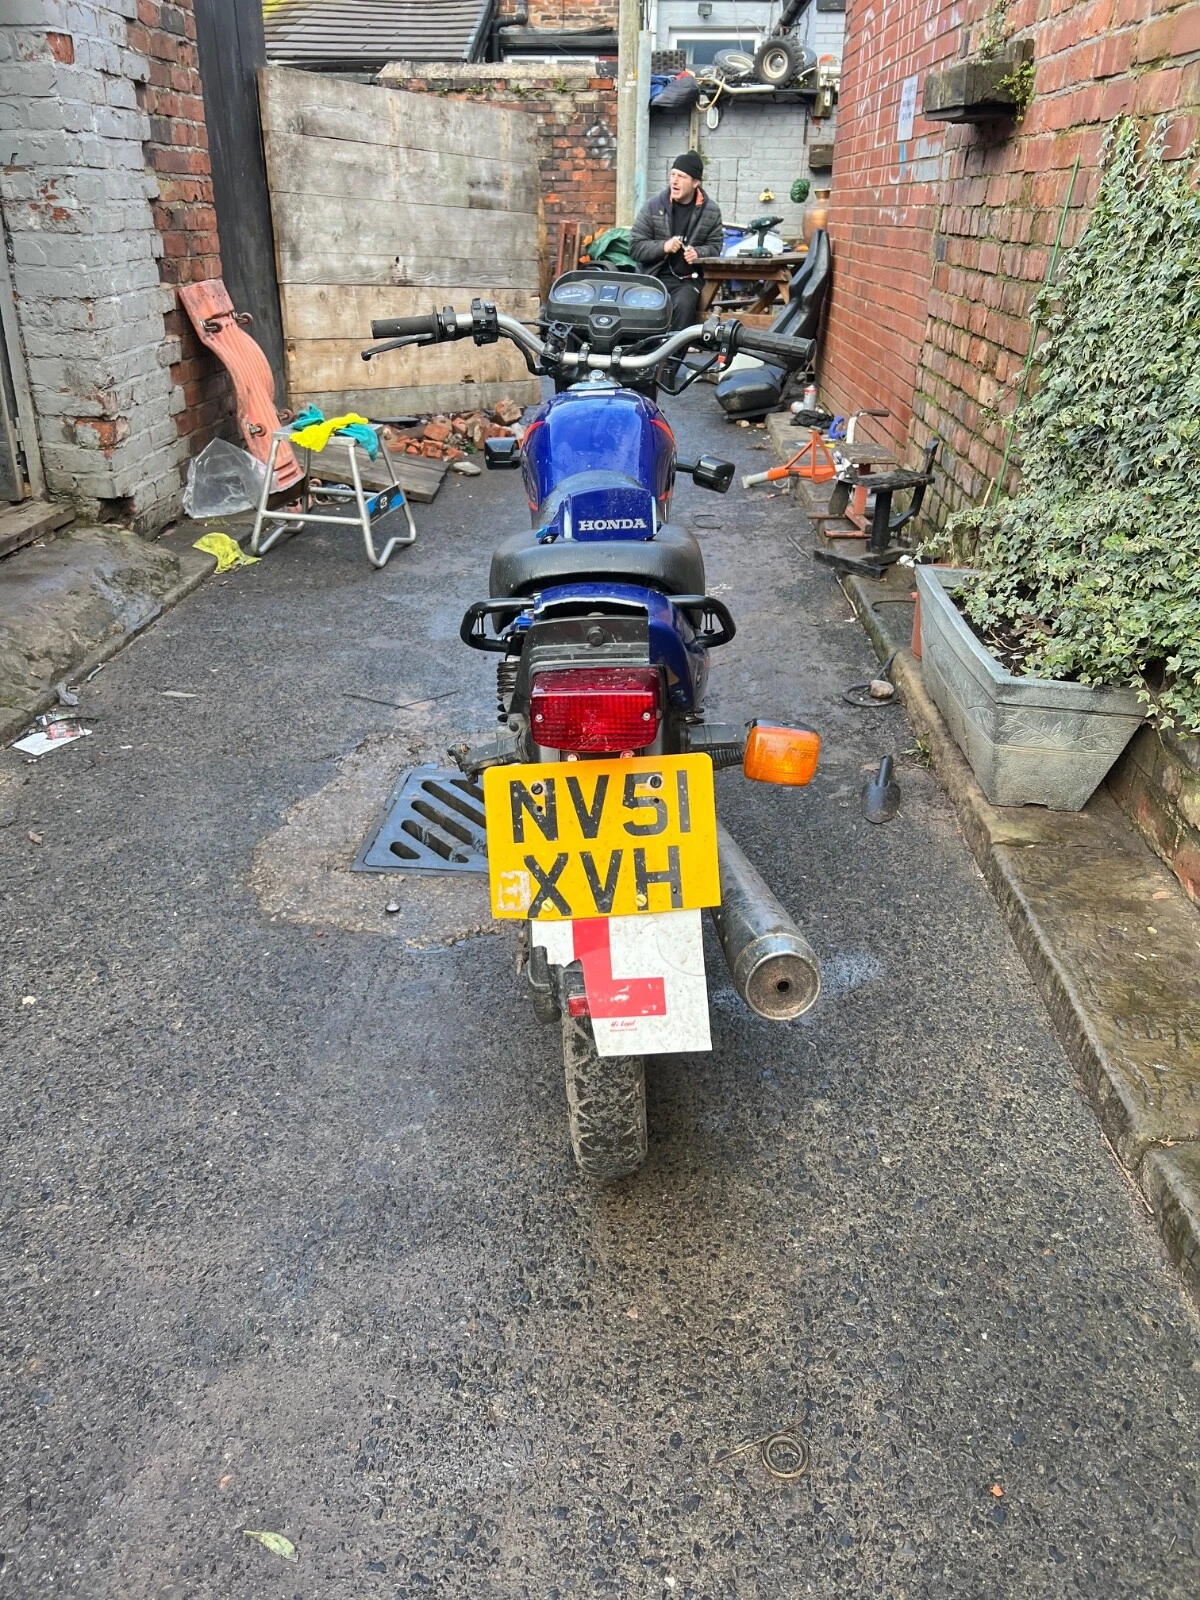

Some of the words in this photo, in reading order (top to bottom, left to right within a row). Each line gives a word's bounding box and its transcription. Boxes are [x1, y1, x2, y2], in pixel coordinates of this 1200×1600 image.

[578, 518, 646, 531] HONDA
[509, 769, 691, 844] NV51
[523, 845, 684, 919] XVH
[572, 917, 667, 1019] L
